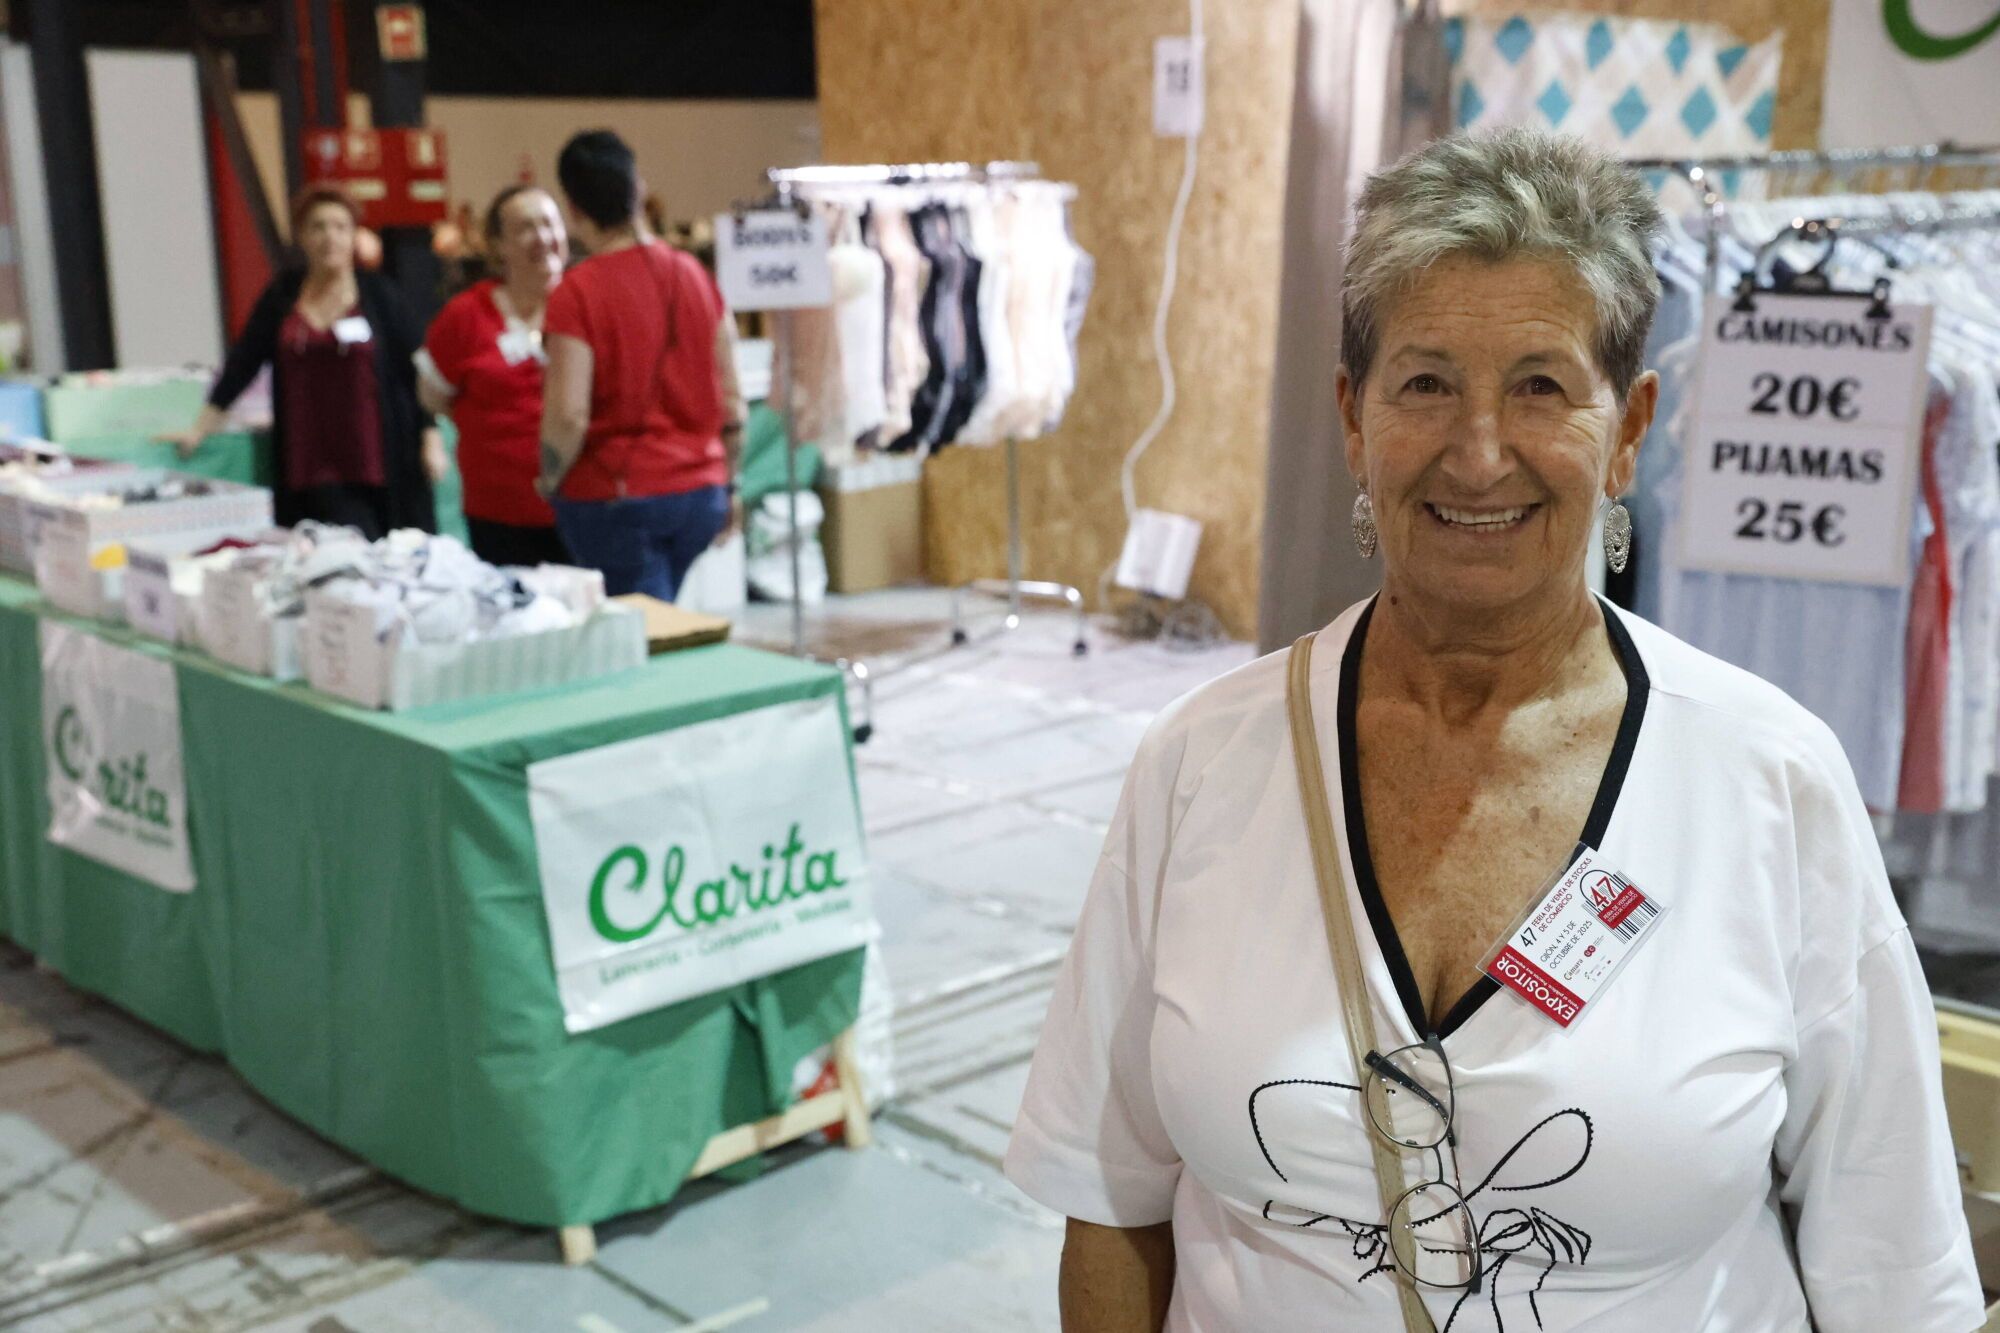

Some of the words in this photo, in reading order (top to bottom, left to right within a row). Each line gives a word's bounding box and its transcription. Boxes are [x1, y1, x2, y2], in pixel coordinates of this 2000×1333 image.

[1716, 311, 1911, 351] CAMISONES
[1750, 372, 1861, 421] 20€
[1712, 441, 1883, 483] PIJAMAS
[1734, 498, 1846, 547] 25€
[588, 822, 848, 943] Clarita
[1520, 927, 1537, 948] 47
[1531, 912, 1546, 927] FERIA
[1544, 903, 1553, 912] DE
[1551, 888, 1567, 903] VENTA
[1565, 878, 1574, 887] DE
[1572, 858, 1592, 879] STOCKS
[1590, 876, 1616, 908] 47
[1538, 923, 1548, 932] DE
[1546, 894, 1572, 923] COMERCIO
[1566, 921, 1576, 930] DE
[1550, 942, 1573, 969] OCTUBRE
[1570, 935, 1580, 944] DE
[1578, 921, 1592, 936] 2025
[1497, 958, 1575, 1019] EXPOSITOR
